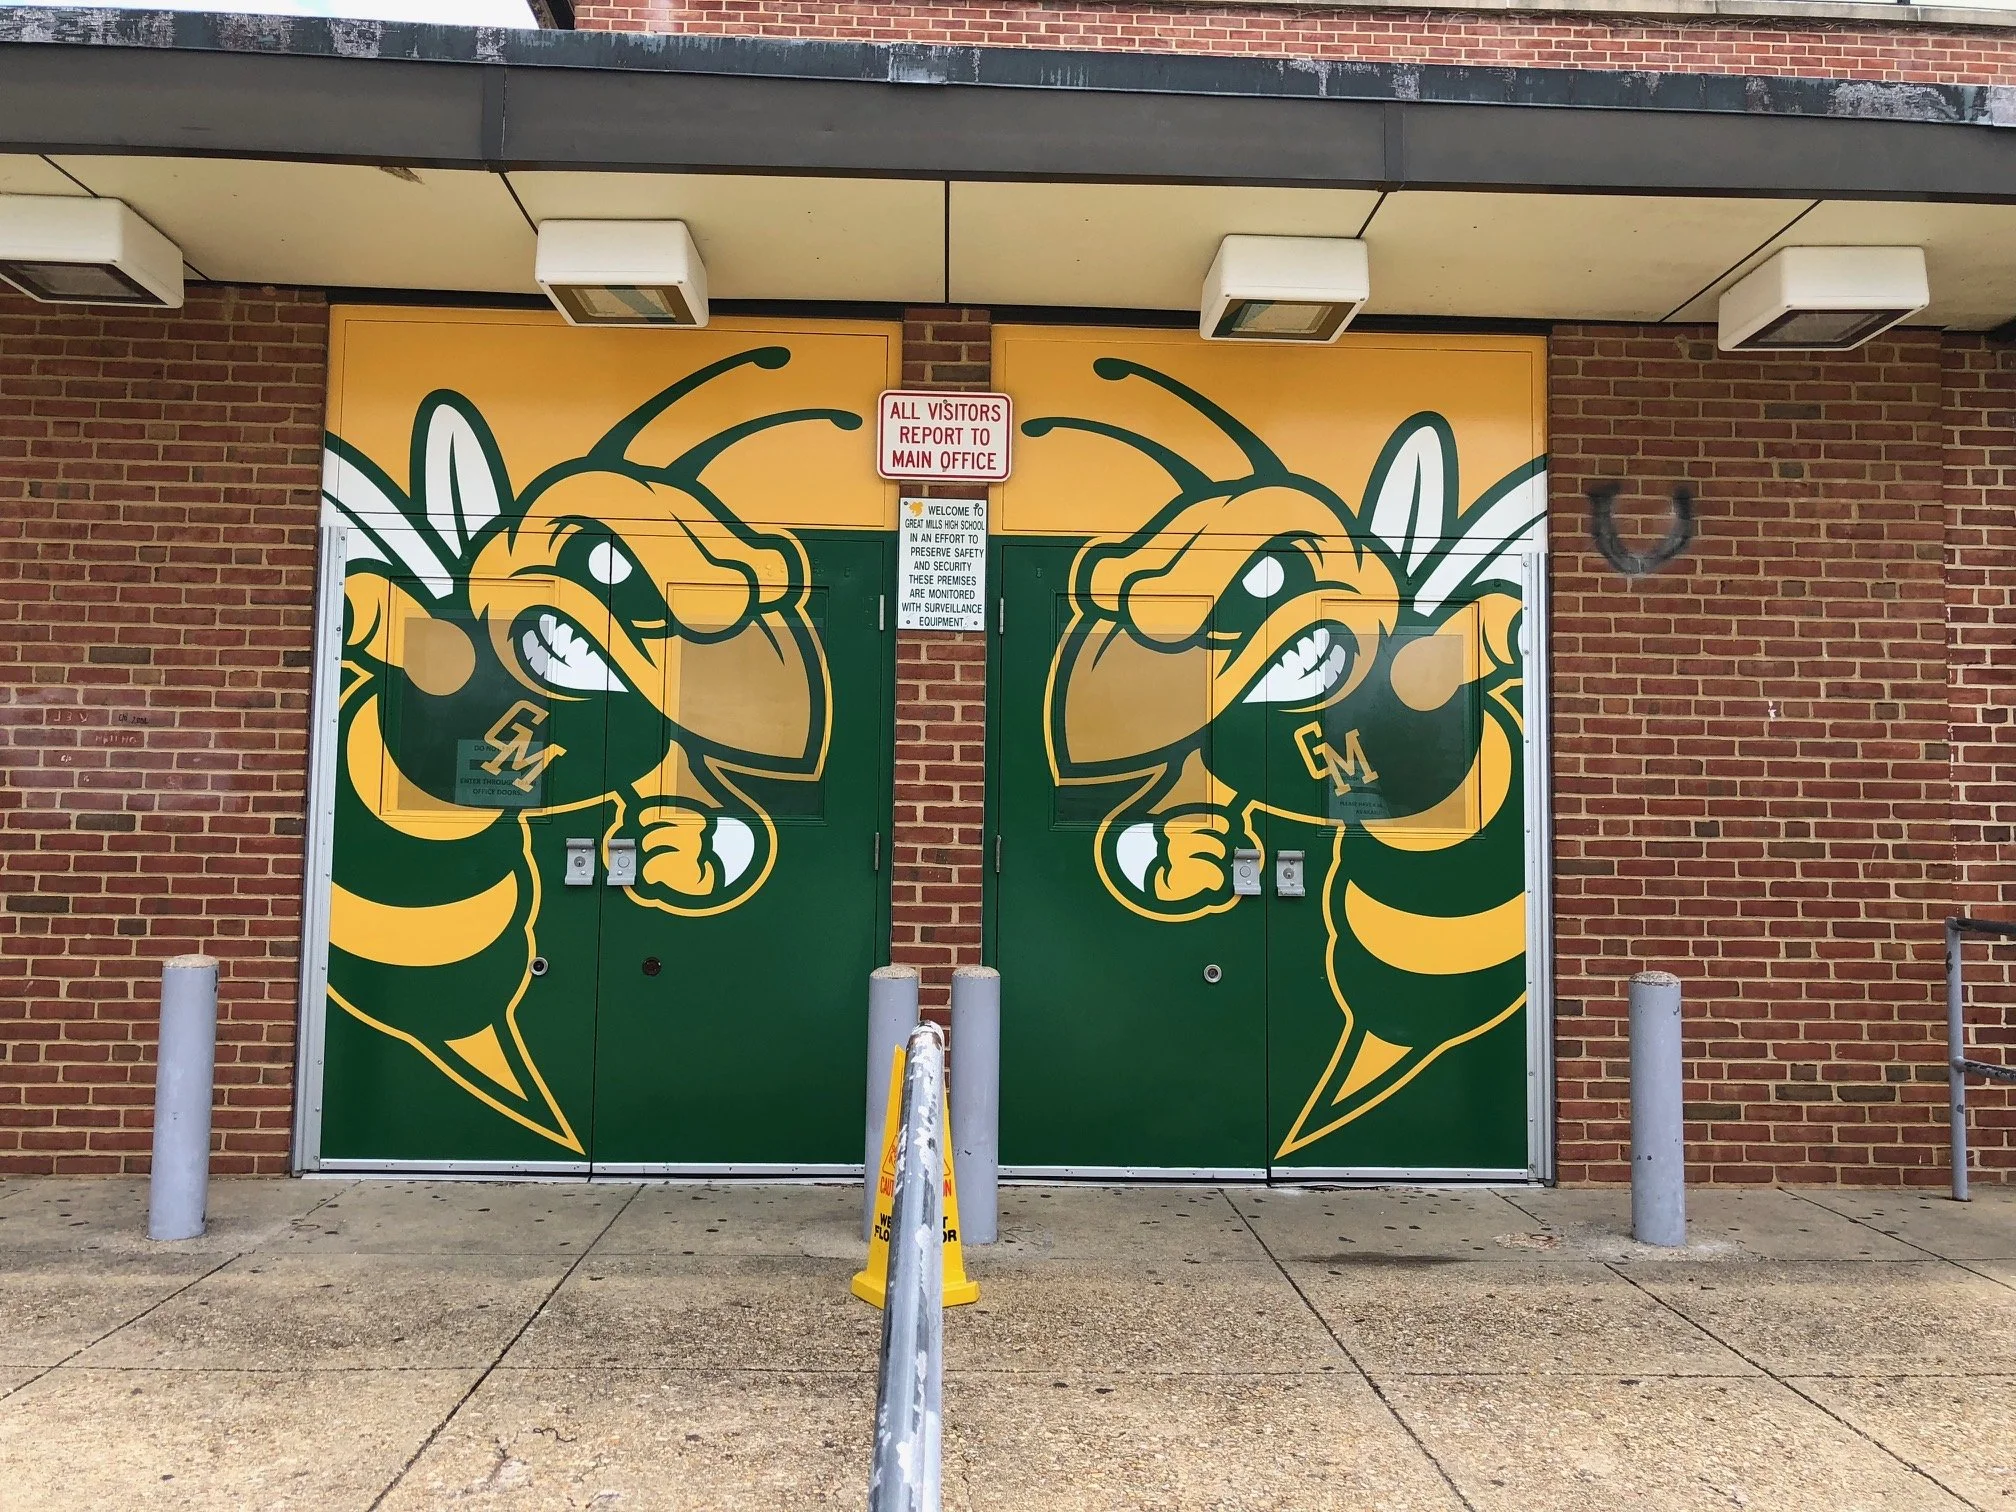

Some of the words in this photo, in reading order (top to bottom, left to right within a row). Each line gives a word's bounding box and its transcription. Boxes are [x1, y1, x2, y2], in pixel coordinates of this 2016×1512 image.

[890, 402, 920, 420] ALL
[928, 402, 1001, 422] VISITORS
[900, 426, 963, 445] REPORT
[971, 428, 990, 446] TO
[892, 450, 931, 468] MAIN
[940, 451, 996, 470] OFFICE
[928, 505, 969, 516] WELCOME
[973, 507, 984, 517] TO
[905, 518, 924, 529] GREAT
[925, 519, 943, 529] MILLS
[944, 520, 959, 530] HIGH
[960, 520, 984, 531] SCHOOL
[909, 533, 918, 543] IN
[921, 533, 932, 543] AN
[935, 533, 965, 544] EFFORT
[968, 534, 979, 545] TO
[910, 547, 951, 558] PRESERVE
[954, 548, 984, 558] SAFETY
[913, 561, 930, 571] AND
[933, 561, 972, 572] SECURITY
[909, 574, 934, 585] THESE
[937, 575, 977, 586] PREMISES
[909, 588, 926, 599] ARE
[928, 589, 976, 600] MONITORED
[901, 602, 922, 612] WITH
[924, 602, 983, 614] SURVEILLANCE
[474, 744, 485, 752] DO
[481, 700, 567, 793] GM
[1293, 720, 1379, 797] GM
[460, 777, 481, 785] ENTER
[472, 788, 495, 796] OFFICE
[880, 1176, 895, 1197] CAUT
[880, 1213, 892, 1228] WE
[874, 1225, 890, 1242] FLO
